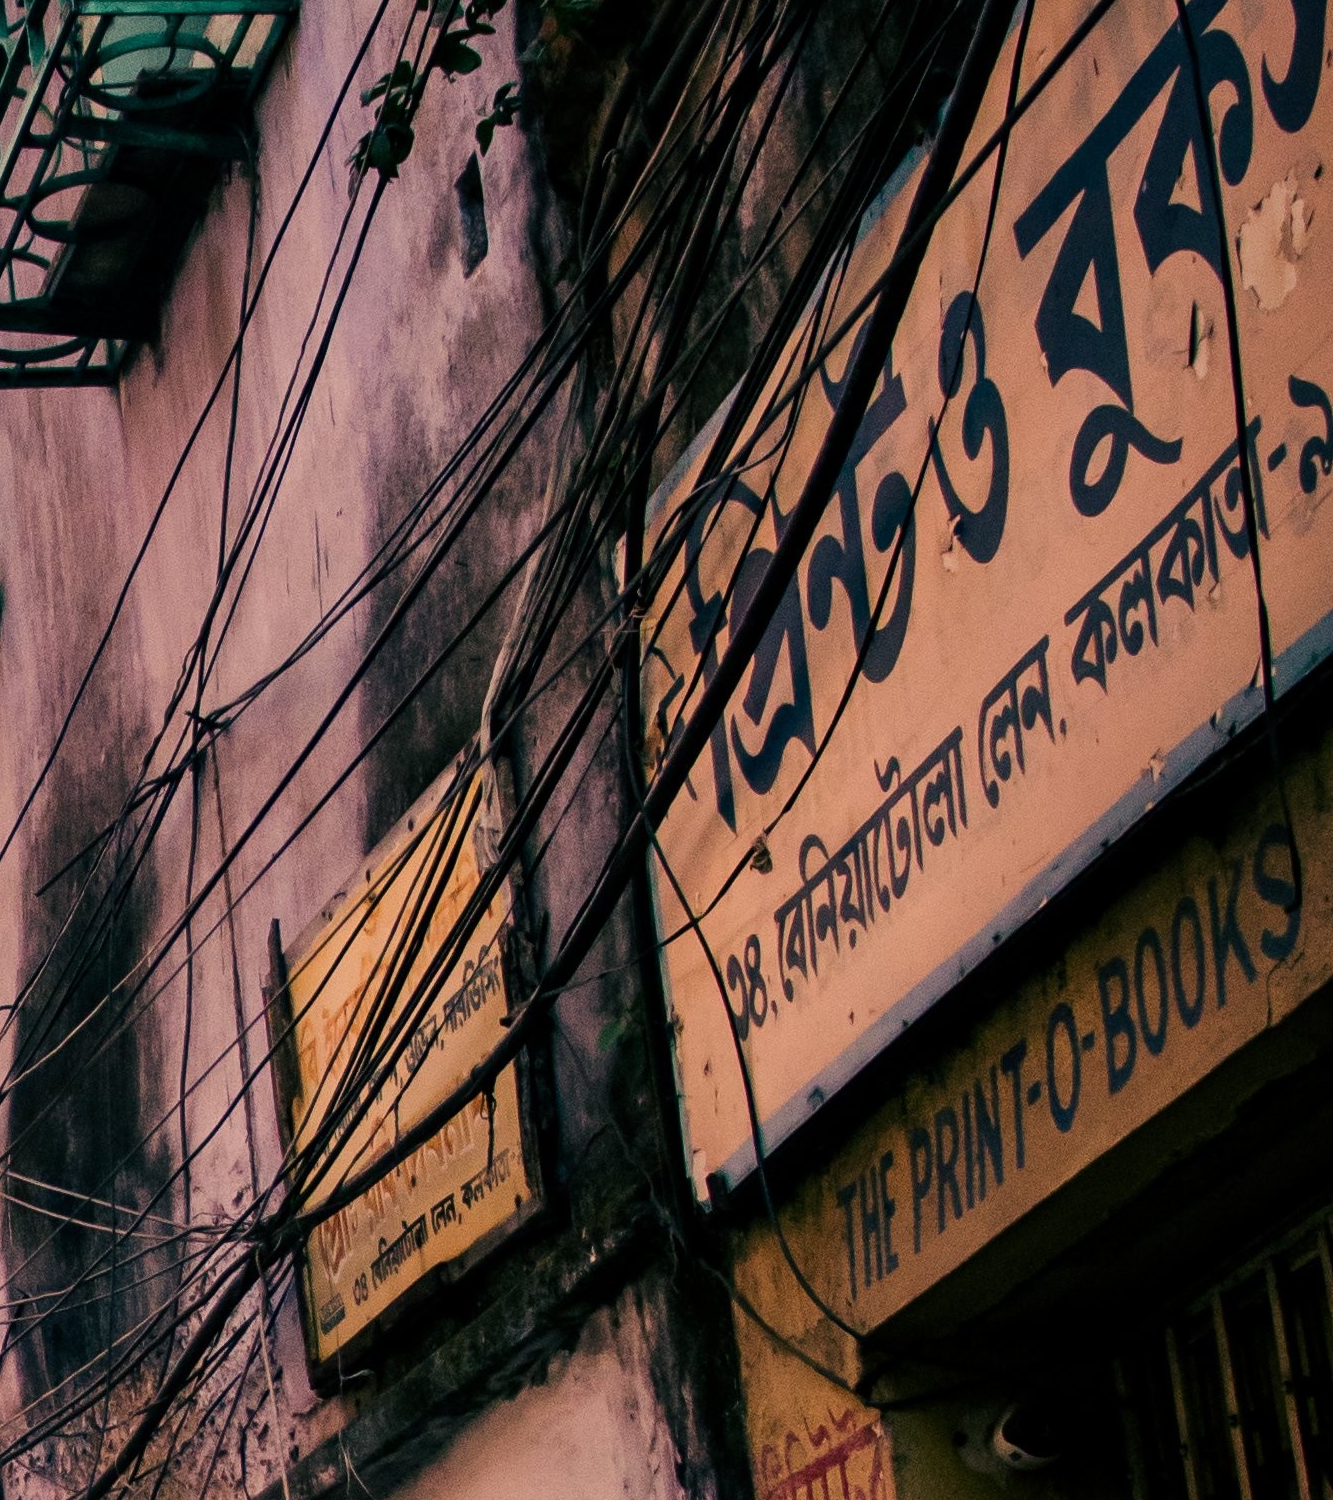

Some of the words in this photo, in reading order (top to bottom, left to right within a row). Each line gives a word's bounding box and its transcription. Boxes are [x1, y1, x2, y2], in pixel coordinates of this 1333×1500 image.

[931, 290, 1010, 564] ও
[836, 1151, 899, 1300] THE
[908, 824, 1303, 1253] PRINT-O-BOOKS
